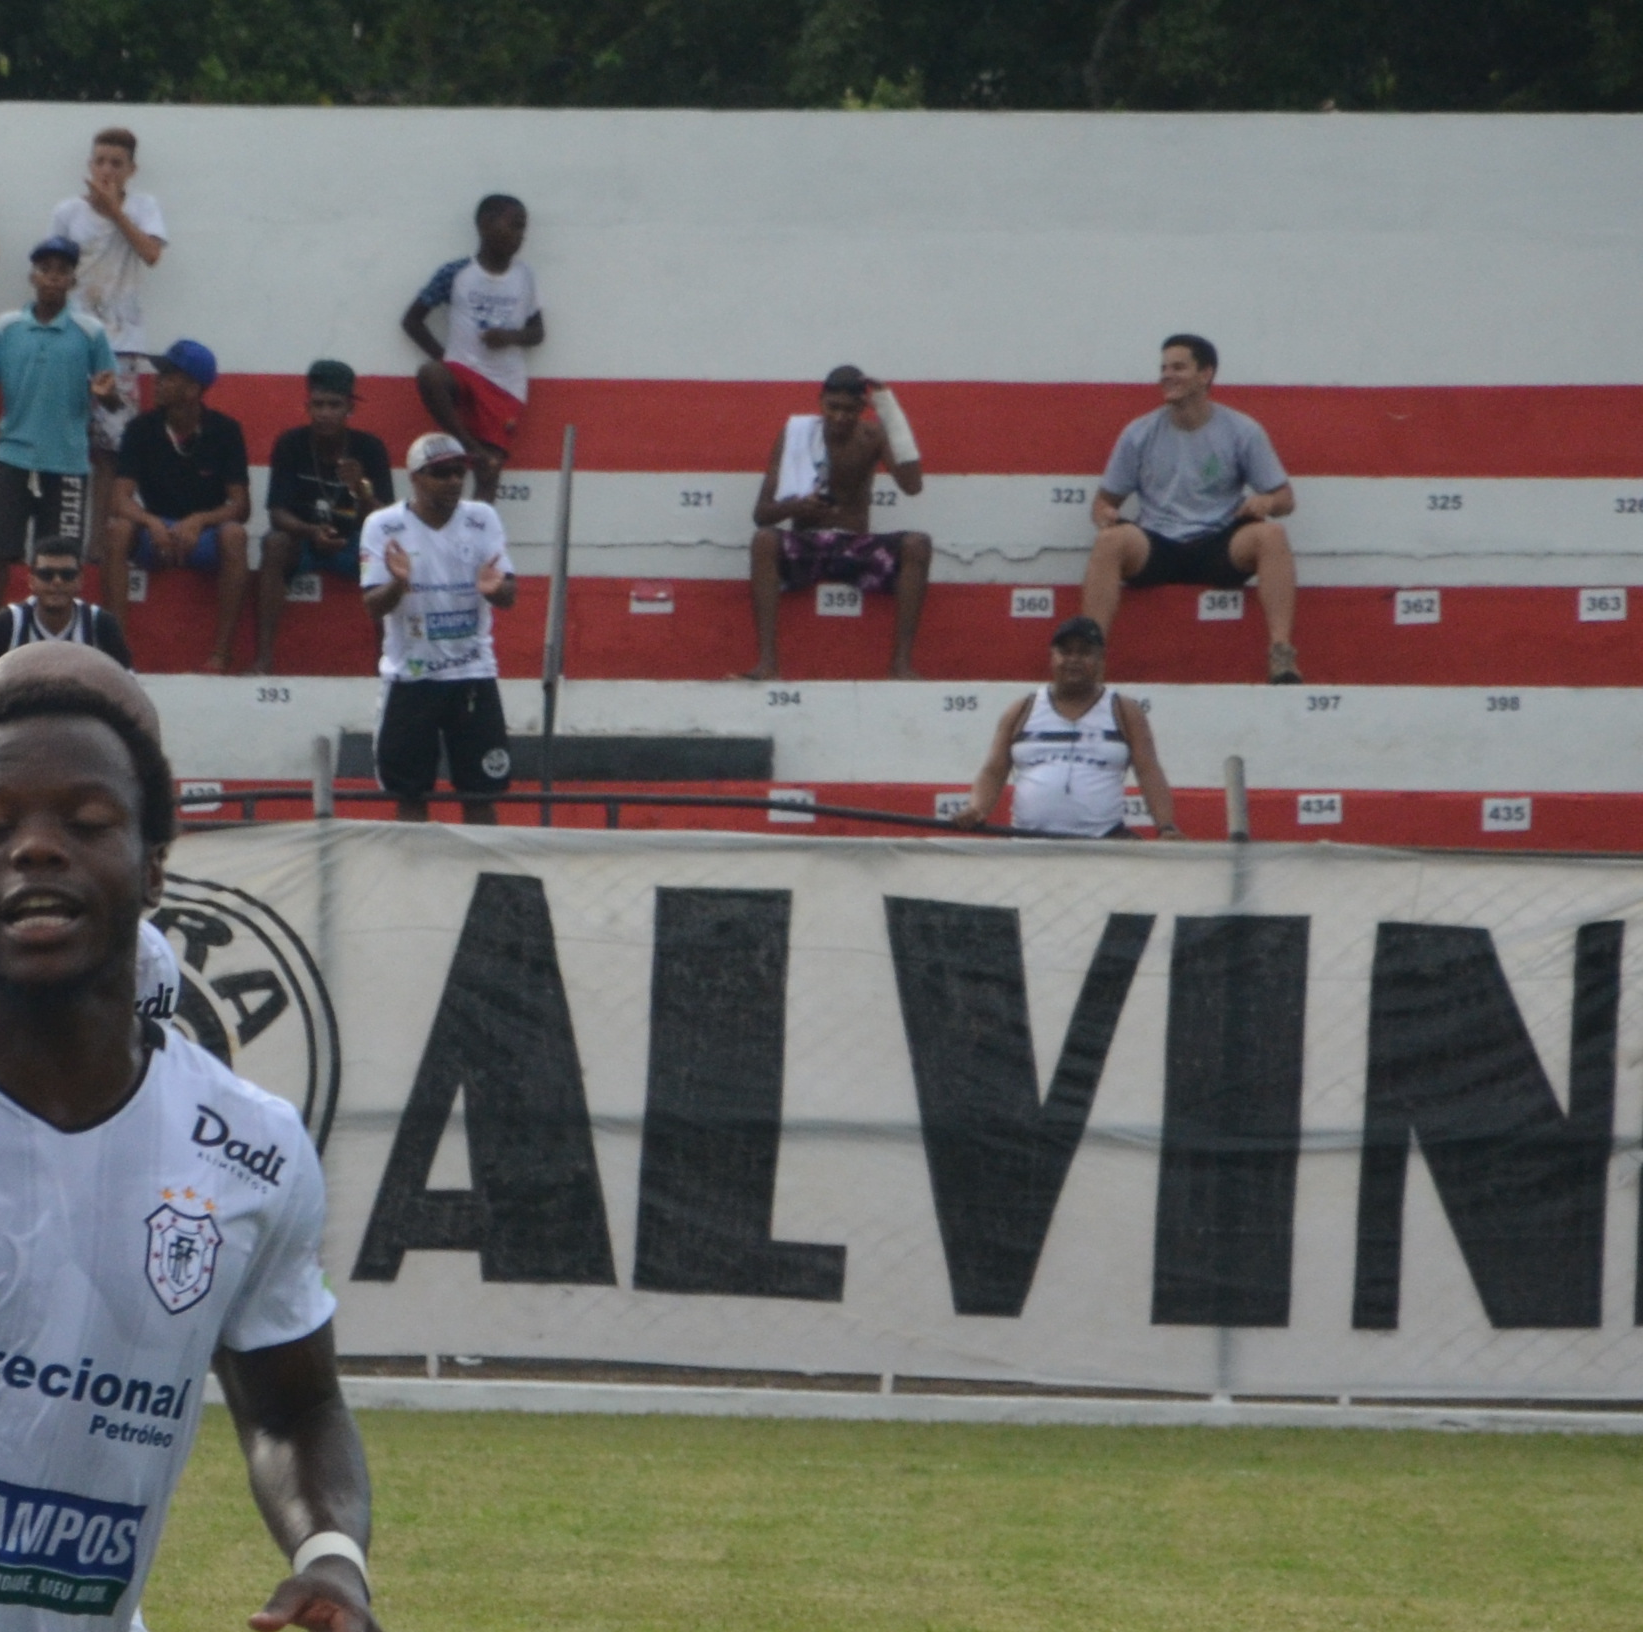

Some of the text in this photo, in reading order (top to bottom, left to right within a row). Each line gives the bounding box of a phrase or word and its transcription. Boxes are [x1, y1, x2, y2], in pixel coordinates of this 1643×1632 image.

[496, 485, 531, 500] 320
[680, 491, 713, 507] 321
[1051, 488, 1086, 503] 323
[1426, 495, 1463, 511] 325
[293, 580, 315, 595] 56
[824, 591, 859, 607] 359
[1014, 596, 1050, 612] 360
[1205, 595, 1240, 611] 361
[1400, 598, 1435, 614] 362
[1585, 597, 1621, 612] 363
[256, 687, 291, 703] 393
[767, 690, 802, 706] 394
[943, 696, 979, 712] 395
[1307, 696, 1342, 712] 397
[1486, 696, 1521, 712] 398
[1300, 800, 1337, 815] 434
[1488, 806, 1525, 822] 435
[352, 872, 1643, 1330] ALVIN
[190, 1103, 287, 1188] Dadi
[88, 1413, 174, 1449] Petróleo
